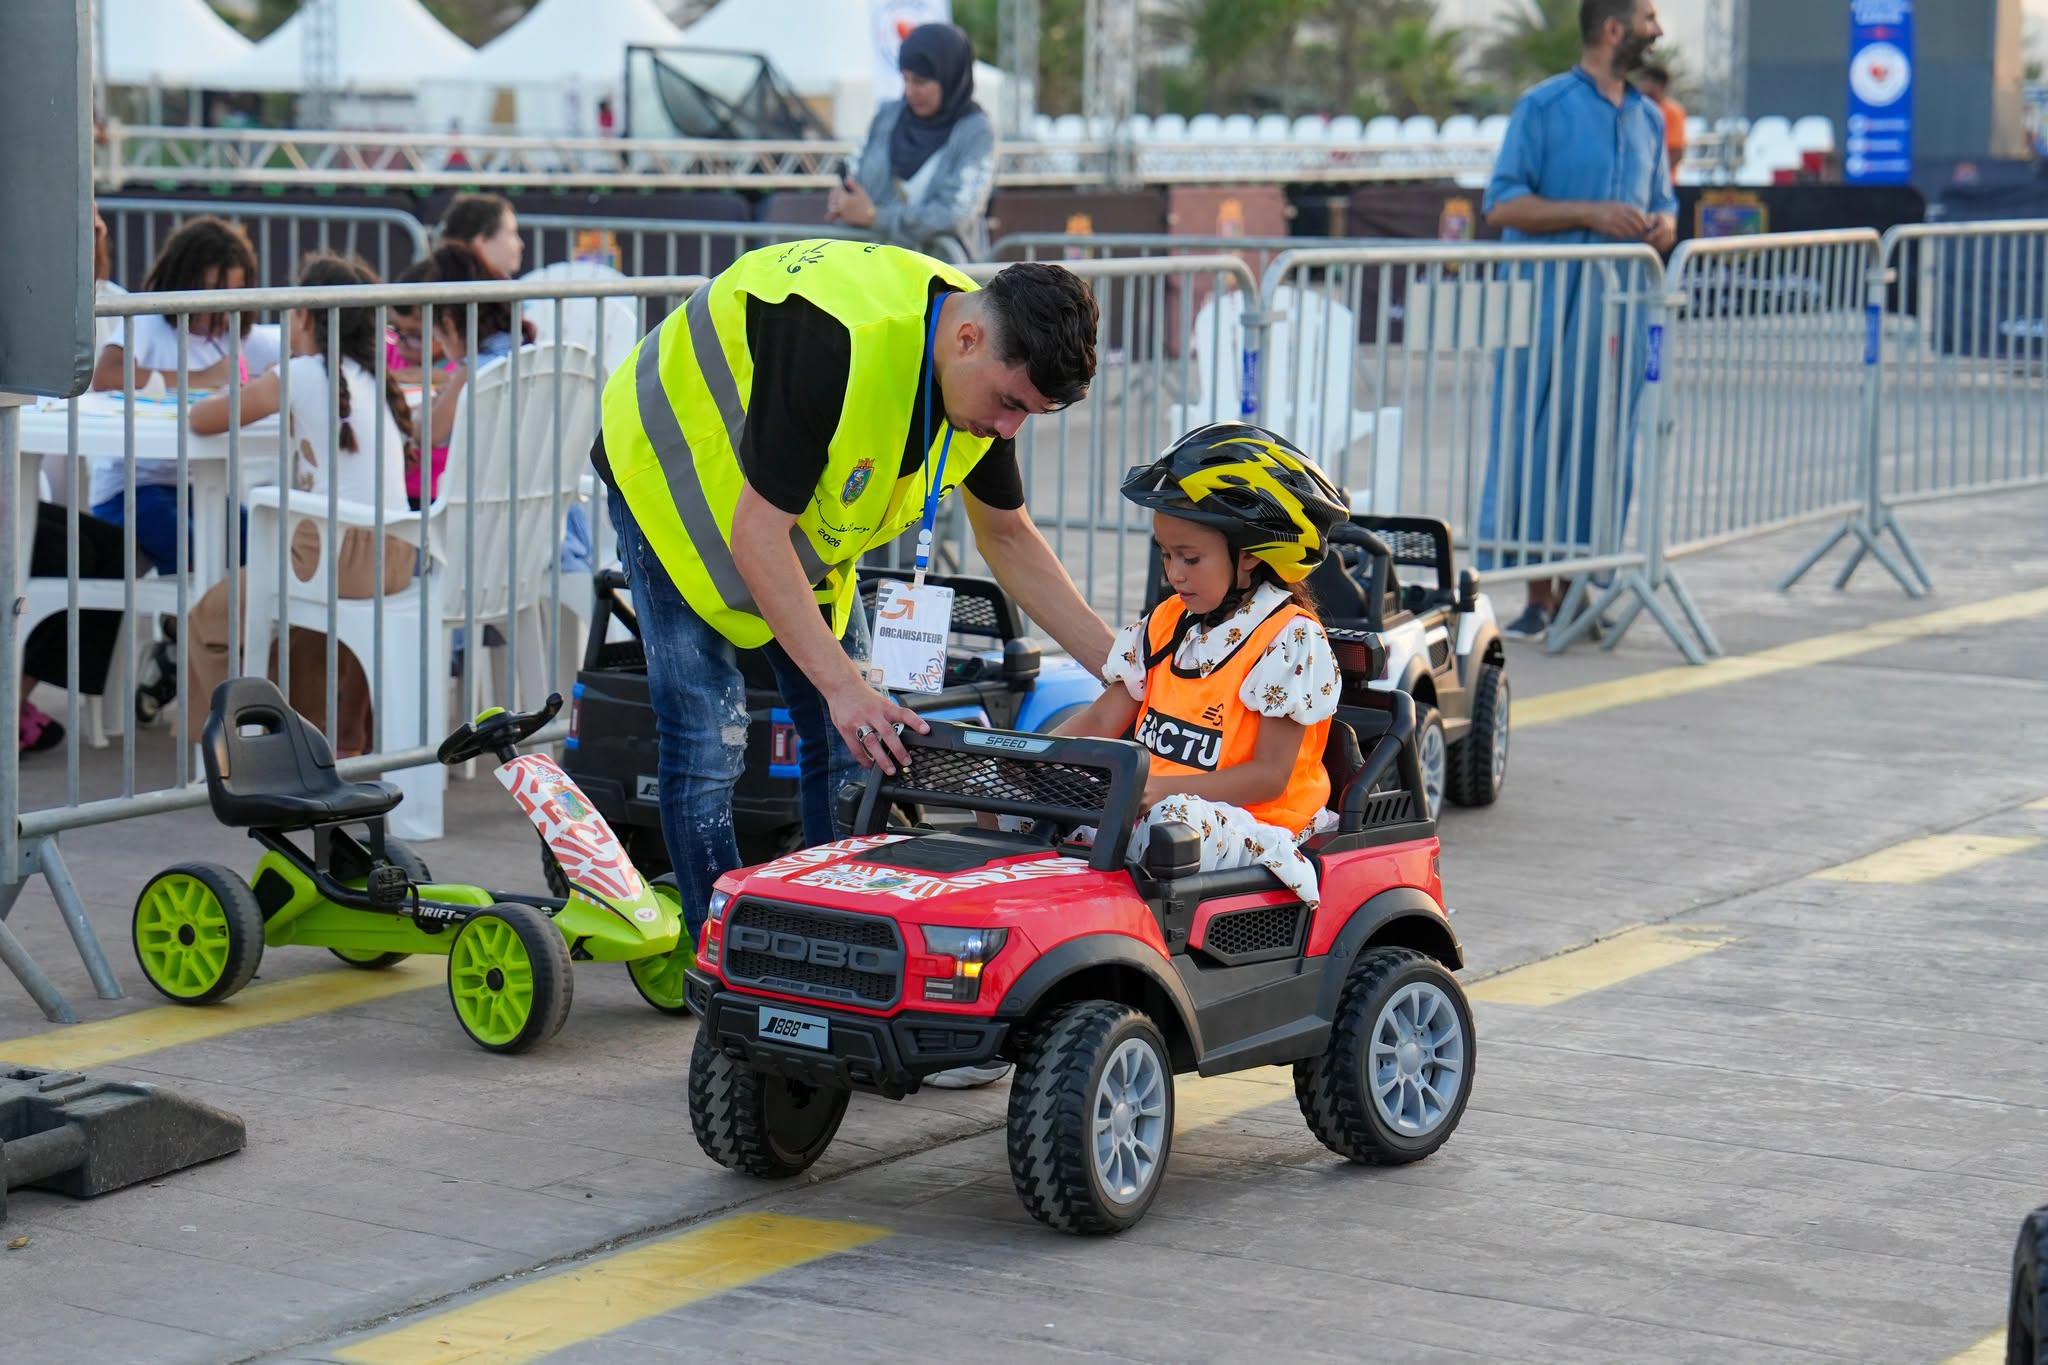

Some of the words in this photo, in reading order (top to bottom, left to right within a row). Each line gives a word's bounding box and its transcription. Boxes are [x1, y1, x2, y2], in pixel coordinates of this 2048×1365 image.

[817, 528, 842, 548] 2026
[880, 626, 943, 644] ORGANISATEUR
[985, 736, 1028, 749] SPEED
